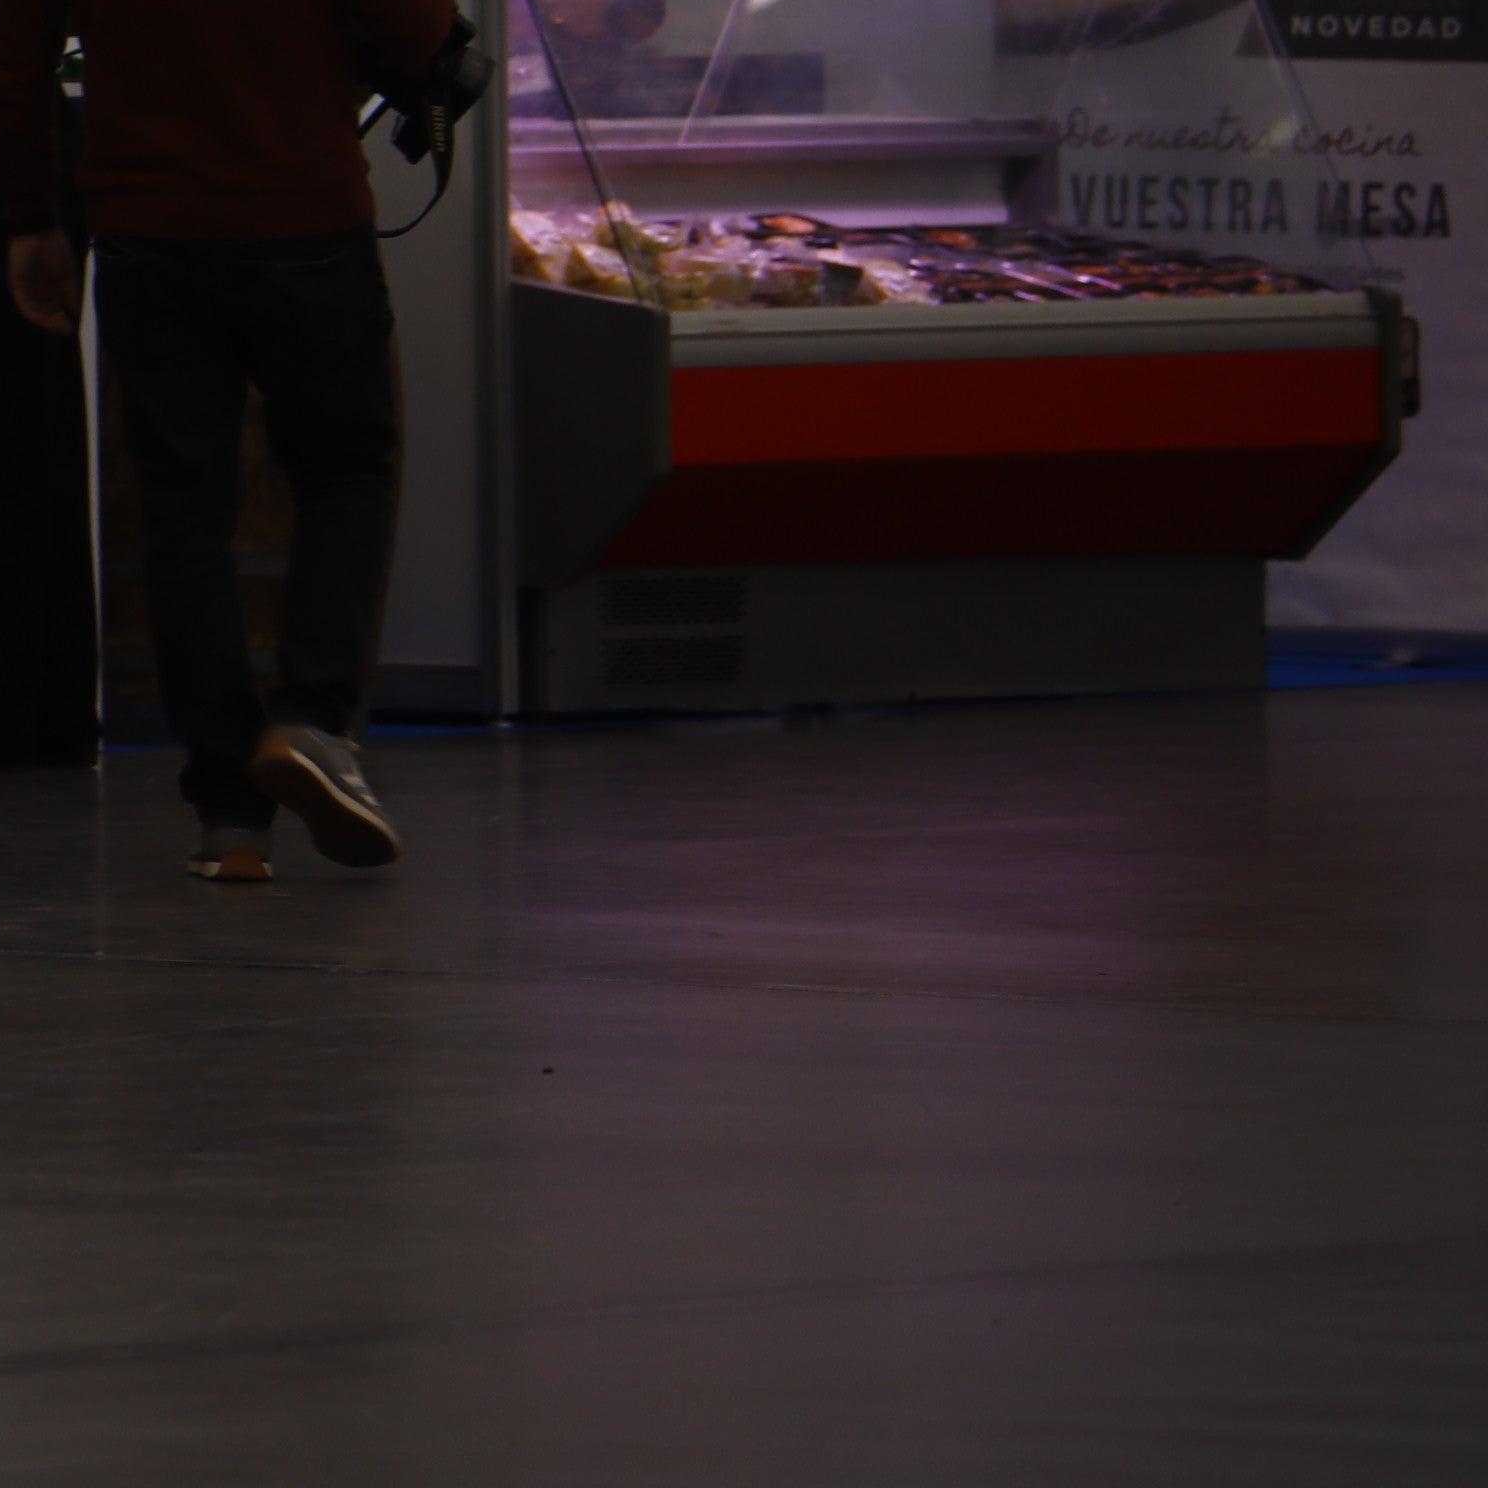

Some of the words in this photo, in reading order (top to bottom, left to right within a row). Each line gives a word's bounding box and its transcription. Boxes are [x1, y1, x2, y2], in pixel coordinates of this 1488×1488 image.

[1289, 13, 1464, 40] NOVEDAD
[1059, 108, 1116, 150] De
[1125, 106, 1282, 153] nuestr
[1069, 173, 1290, 234] VUESTRA
[1316, 180, 1453, 240] MESA
